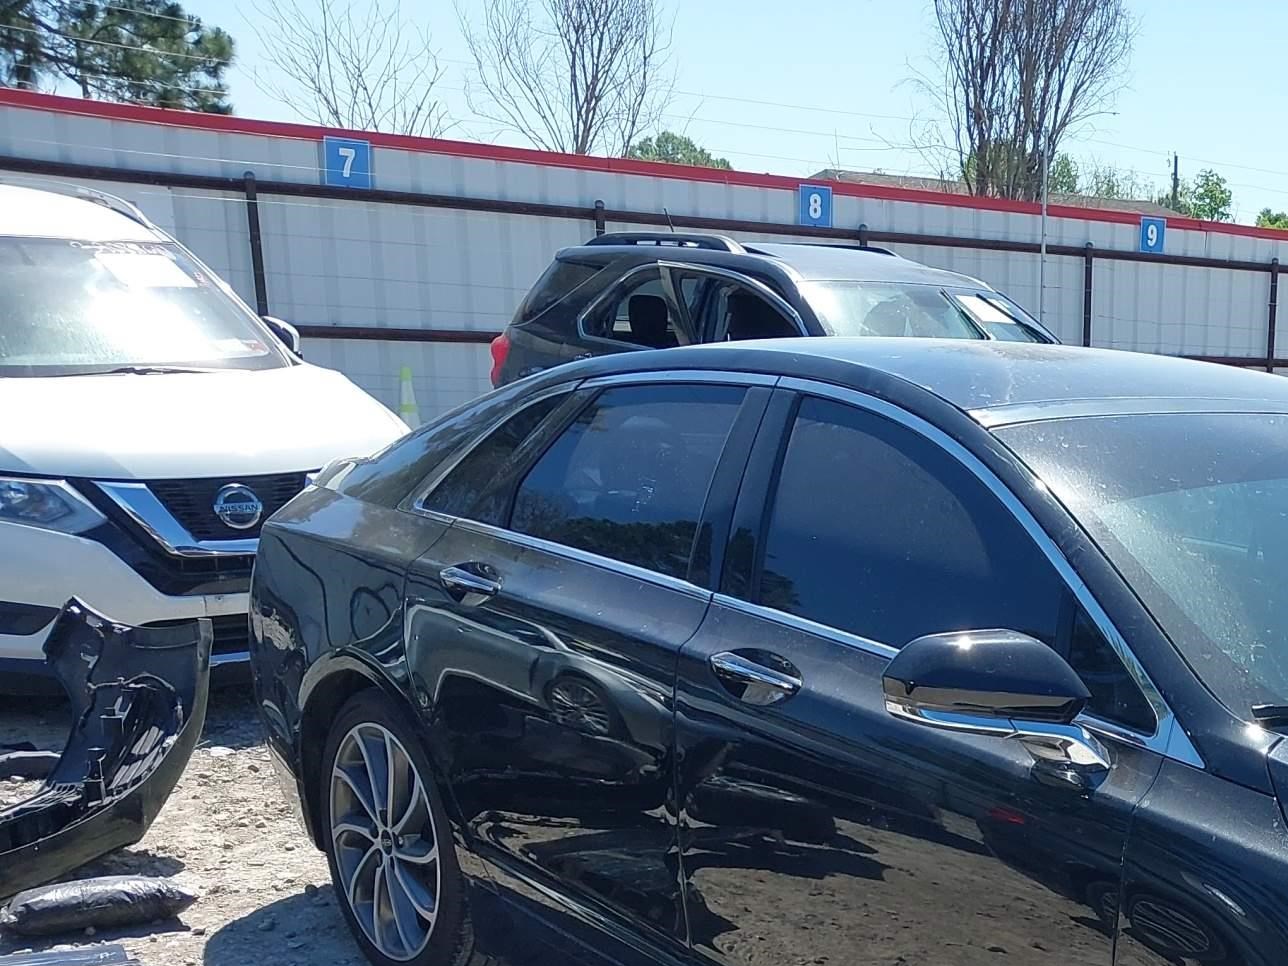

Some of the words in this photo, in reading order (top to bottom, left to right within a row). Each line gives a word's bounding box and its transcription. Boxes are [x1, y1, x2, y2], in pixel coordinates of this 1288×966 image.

[339, 147, 356, 178] 7
[809, 193, 822, 219] 8
[1147, 224, 1158, 247] 9
